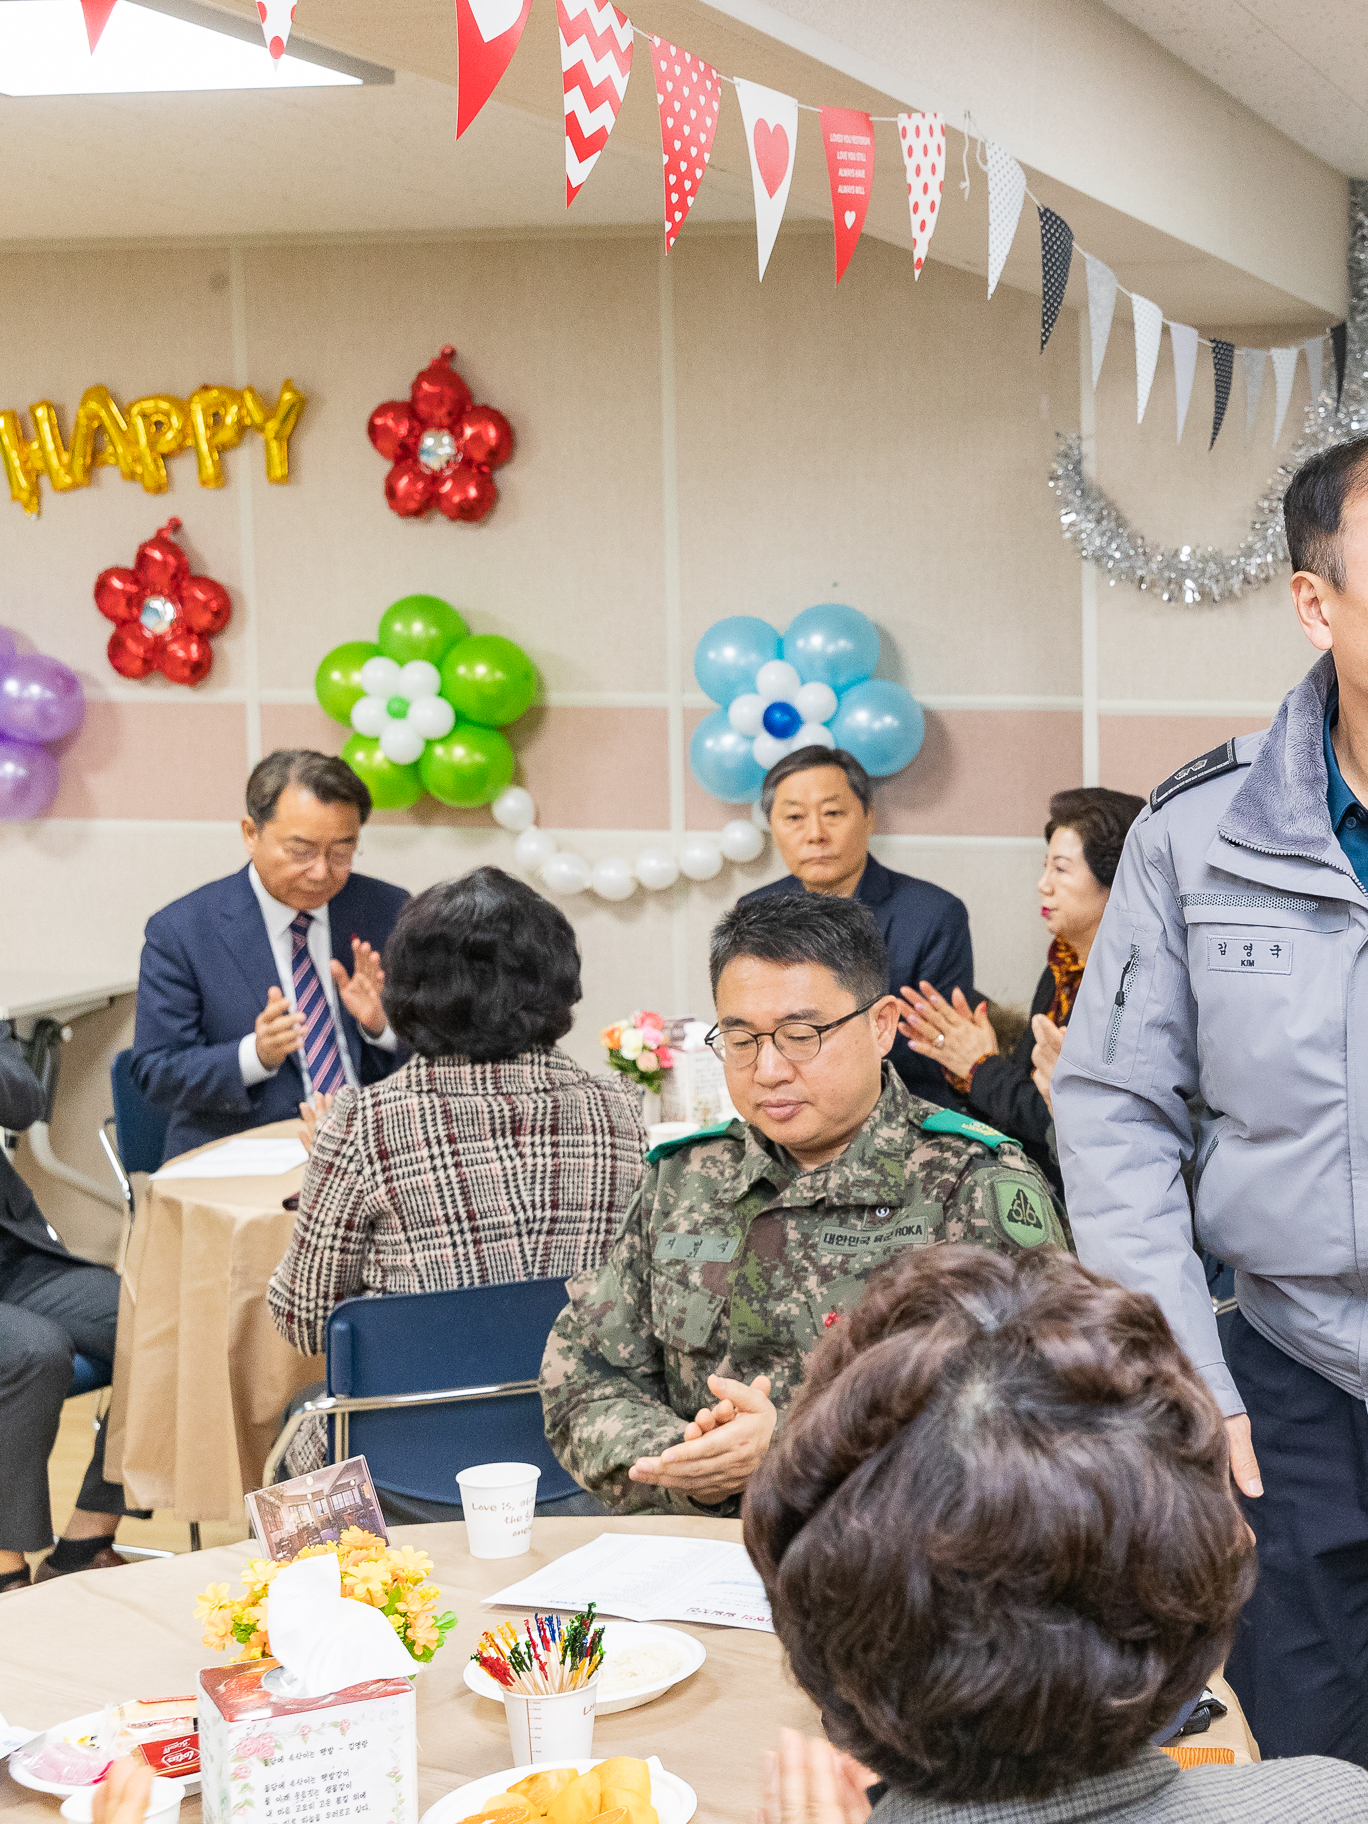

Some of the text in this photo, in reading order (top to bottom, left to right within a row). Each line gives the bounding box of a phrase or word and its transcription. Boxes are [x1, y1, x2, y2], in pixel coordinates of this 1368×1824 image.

[0, 378, 305, 516] HAPPY
[1241, 959, 1254, 967] KIM
[823, 1233, 870, 1247] 대한민국
[895, 1224, 922, 1237] ROKA
[471, 1502, 497, 1512] Love
[505, 1516, 522, 1524] the
